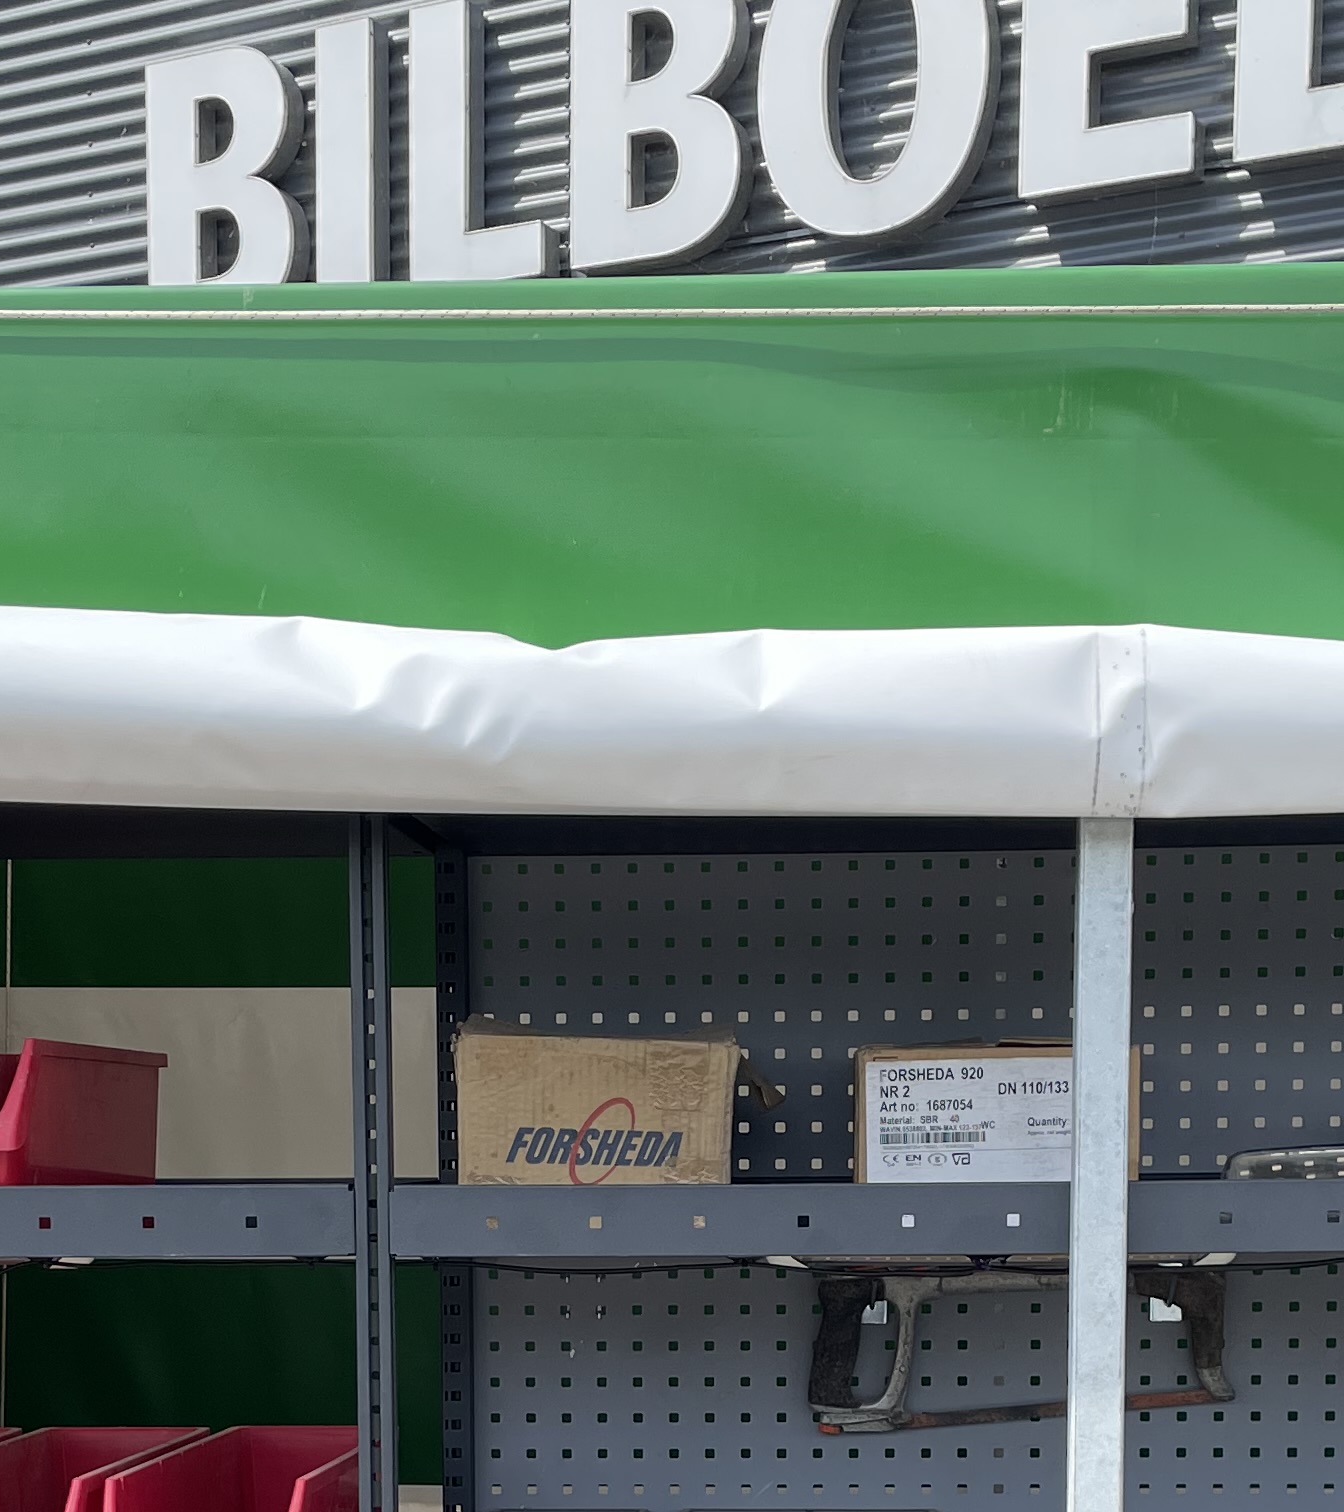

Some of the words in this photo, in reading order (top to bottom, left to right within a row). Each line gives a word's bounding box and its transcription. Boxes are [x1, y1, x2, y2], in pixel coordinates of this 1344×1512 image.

[879, 1068, 955, 1081] FORSHEDA
[961, 1066, 984, 1080] 920
[880, 1085, 899, 1098] NR
[902, 1085, 910, 1097] 2
[998, 1082, 1017, 1095] DN
[1021, 1081, 1069, 1094] 110/133
[879, 1101, 897, 1112] Art
[926, 1099, 973, 1111] 1687054
[920, 1115, 938, 1124] SBR
[506, 1127, 684, 1167] FORSHEDA
